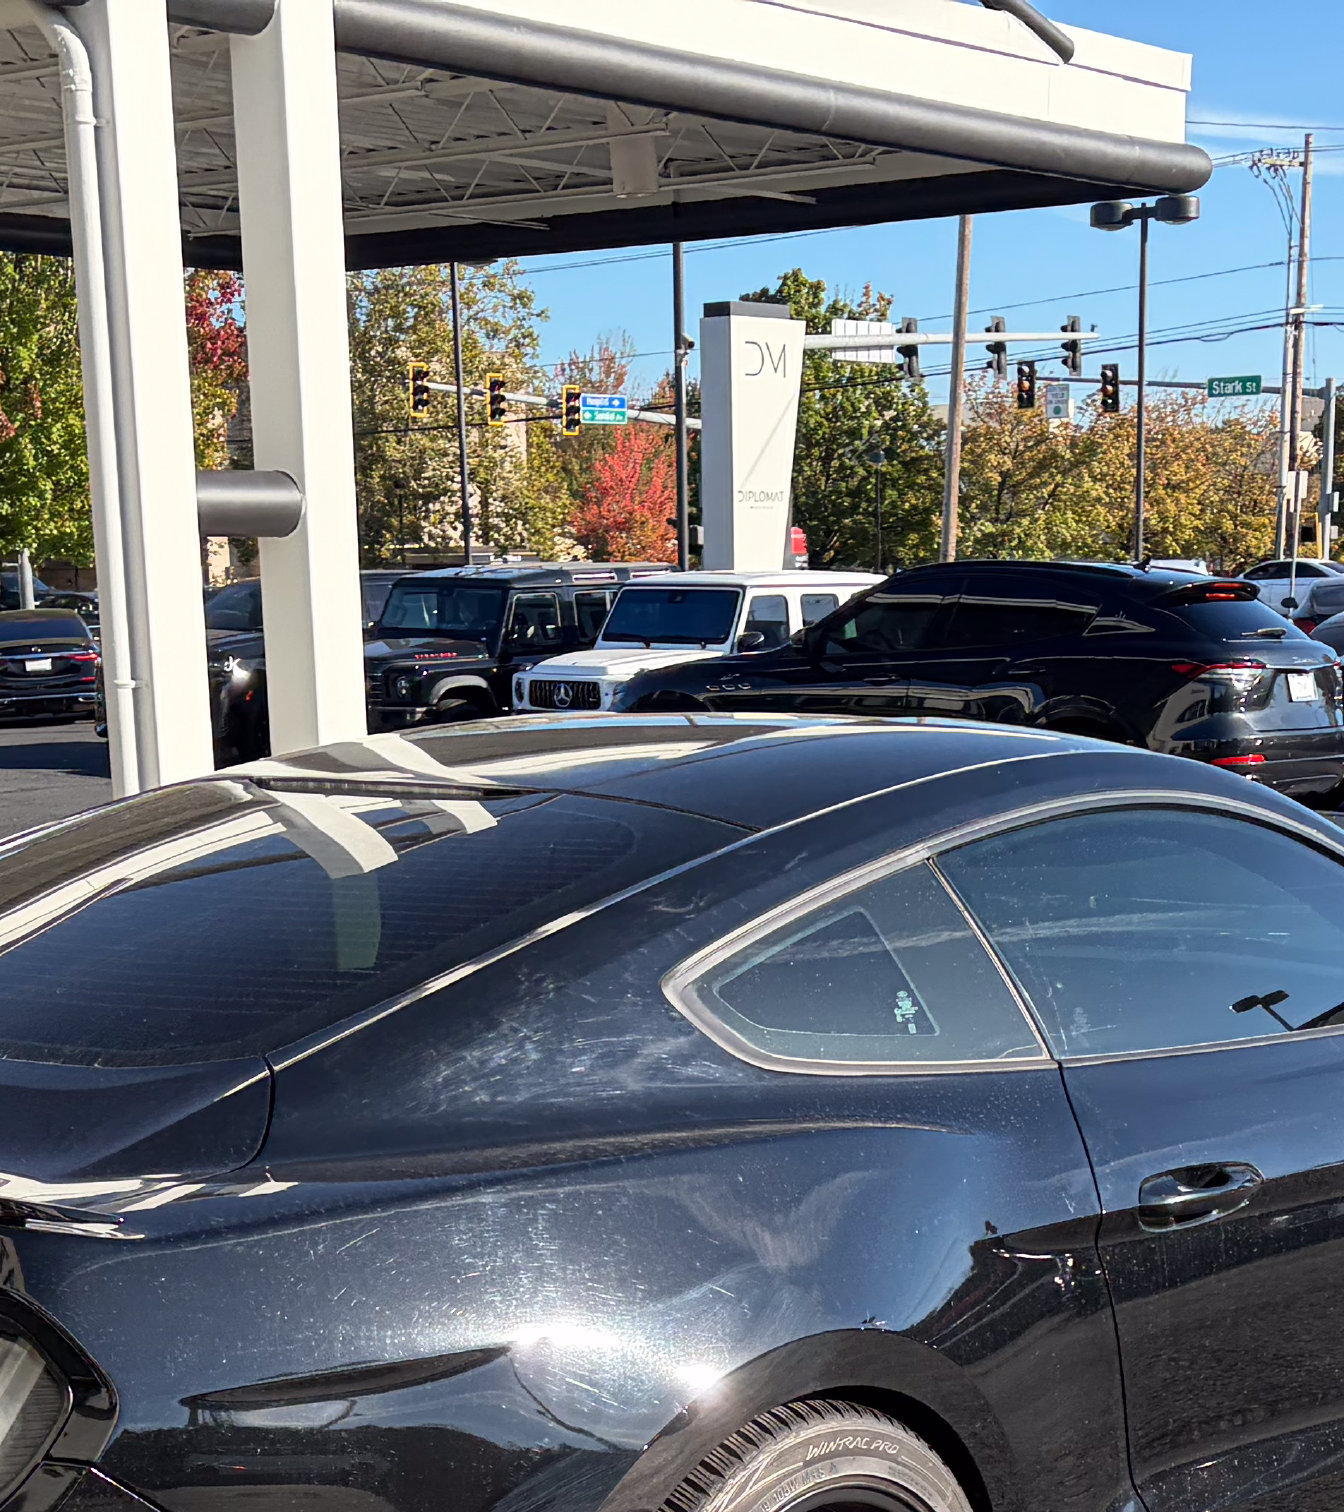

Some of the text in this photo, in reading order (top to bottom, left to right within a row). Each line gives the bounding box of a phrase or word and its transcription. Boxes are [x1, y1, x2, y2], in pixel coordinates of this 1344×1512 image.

[1212, 380, 1243, 394] Stark
[737, 490, 784, 502] DIPLOMAT
[806, 1436, 900, 1460] WINTRAC PRO
